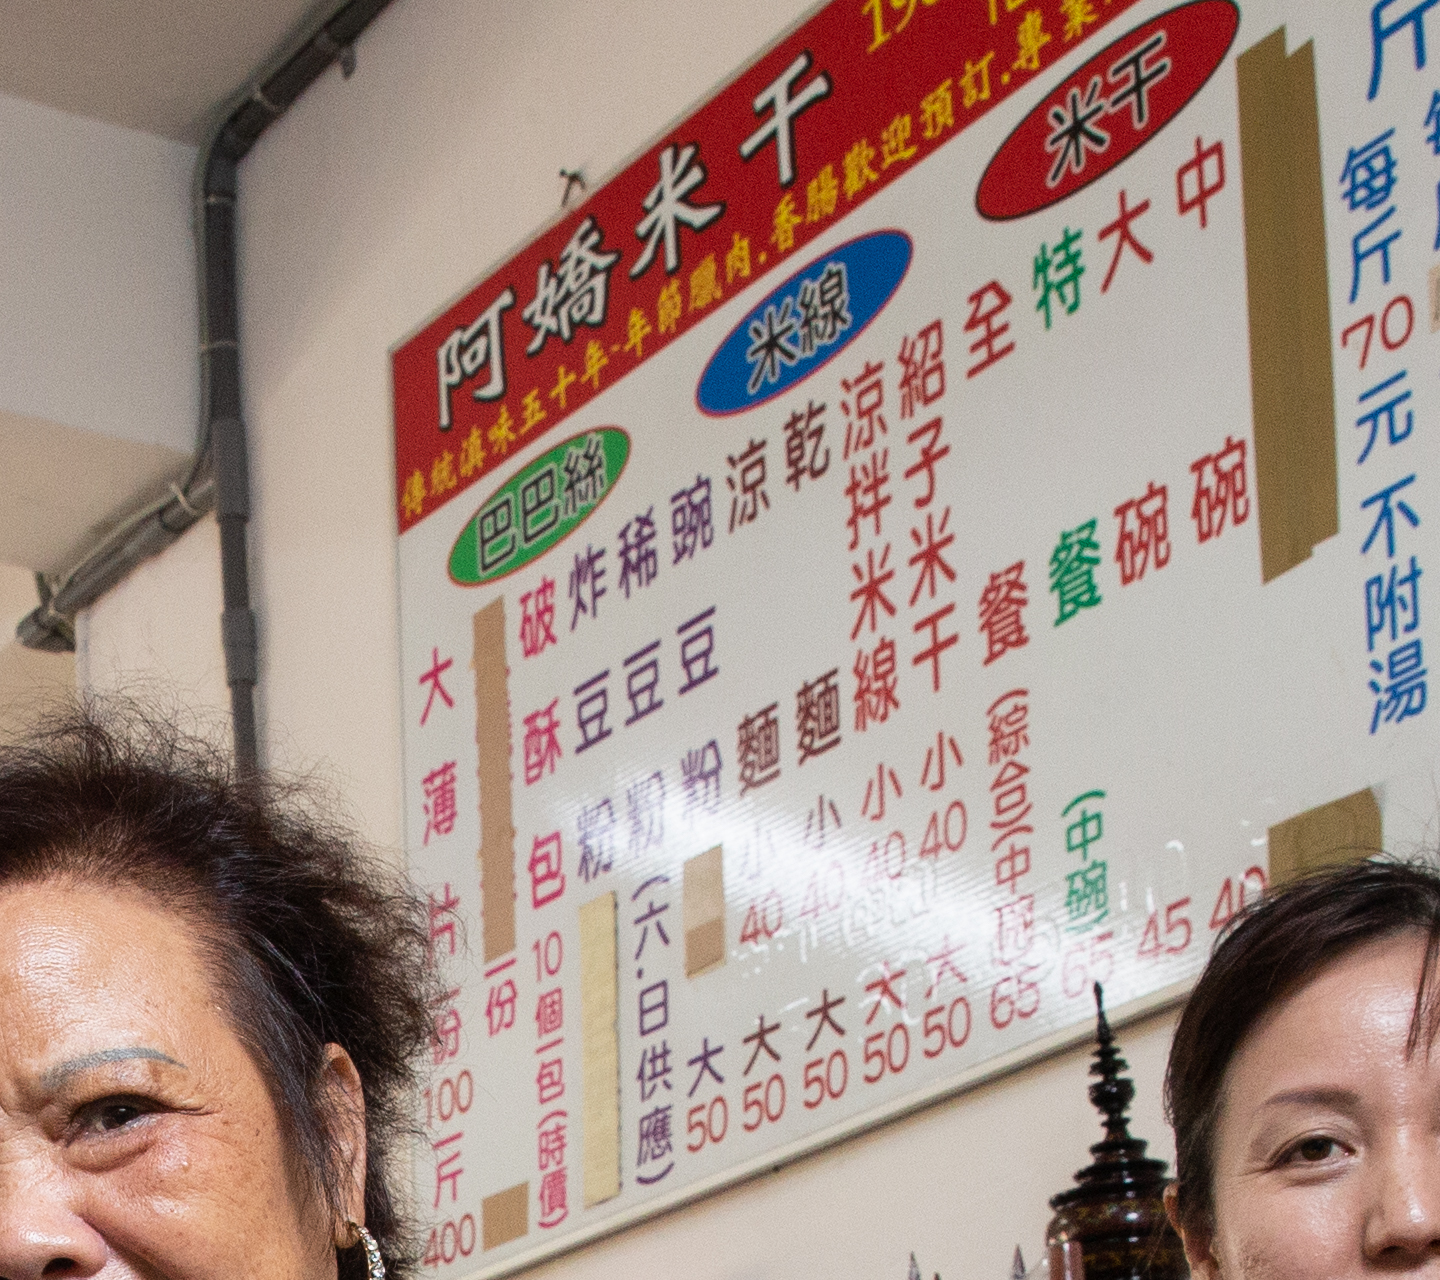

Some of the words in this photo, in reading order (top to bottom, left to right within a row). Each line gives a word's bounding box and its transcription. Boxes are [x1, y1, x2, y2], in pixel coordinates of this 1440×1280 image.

[1047, 30, 1171, 188] 米干
[436, 50, 834, 431] 阿嬌米干
[747, 262, 852, 394] 米線
[477, 434, 607, 573] 巴巴絲
